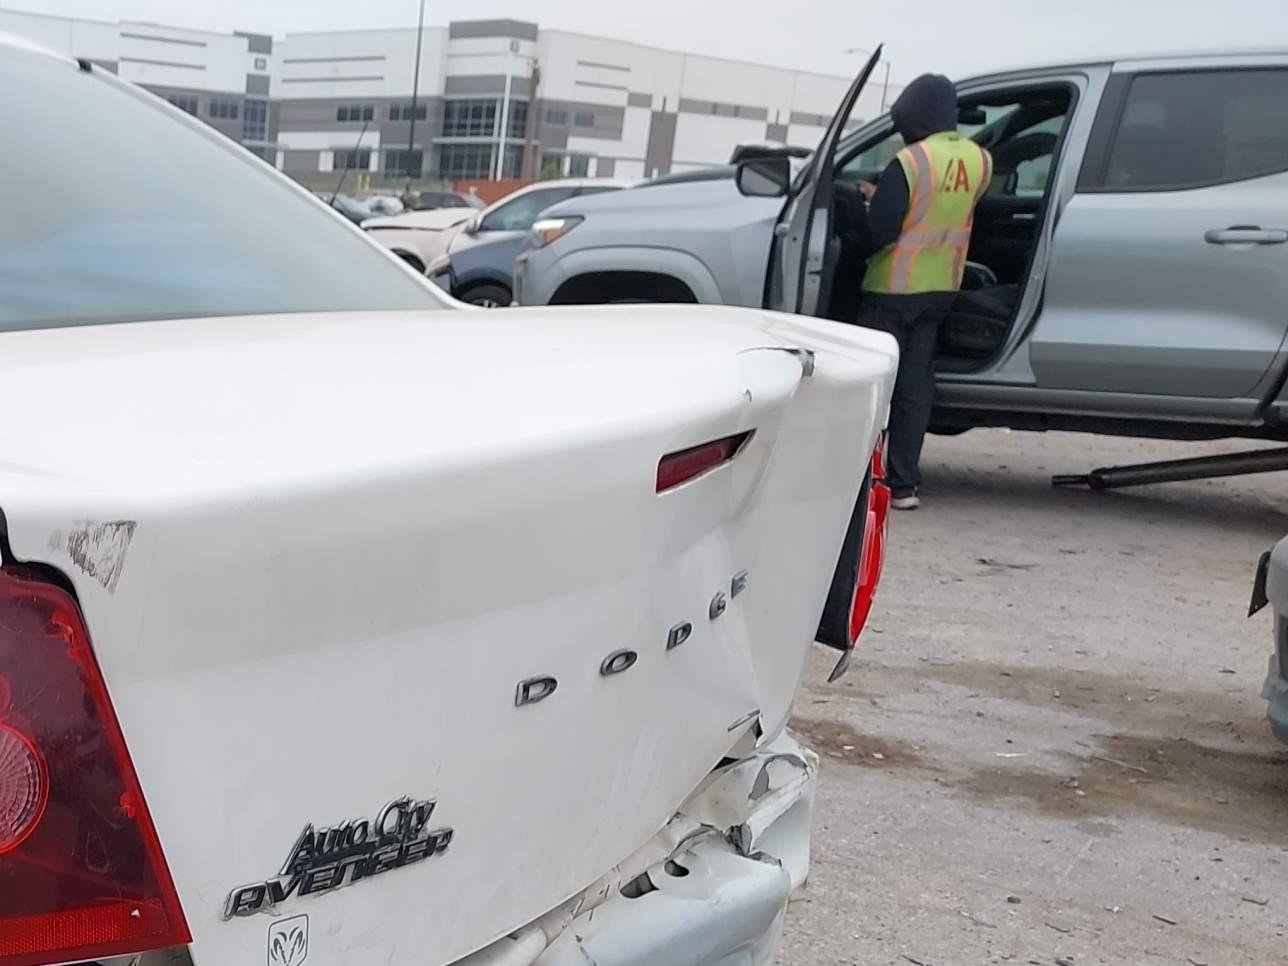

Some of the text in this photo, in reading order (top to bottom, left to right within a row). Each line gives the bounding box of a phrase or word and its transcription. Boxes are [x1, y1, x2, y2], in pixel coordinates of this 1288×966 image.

[514, 570, 749, 706] DODGE
[279, 794, 438, 875] Auto City
